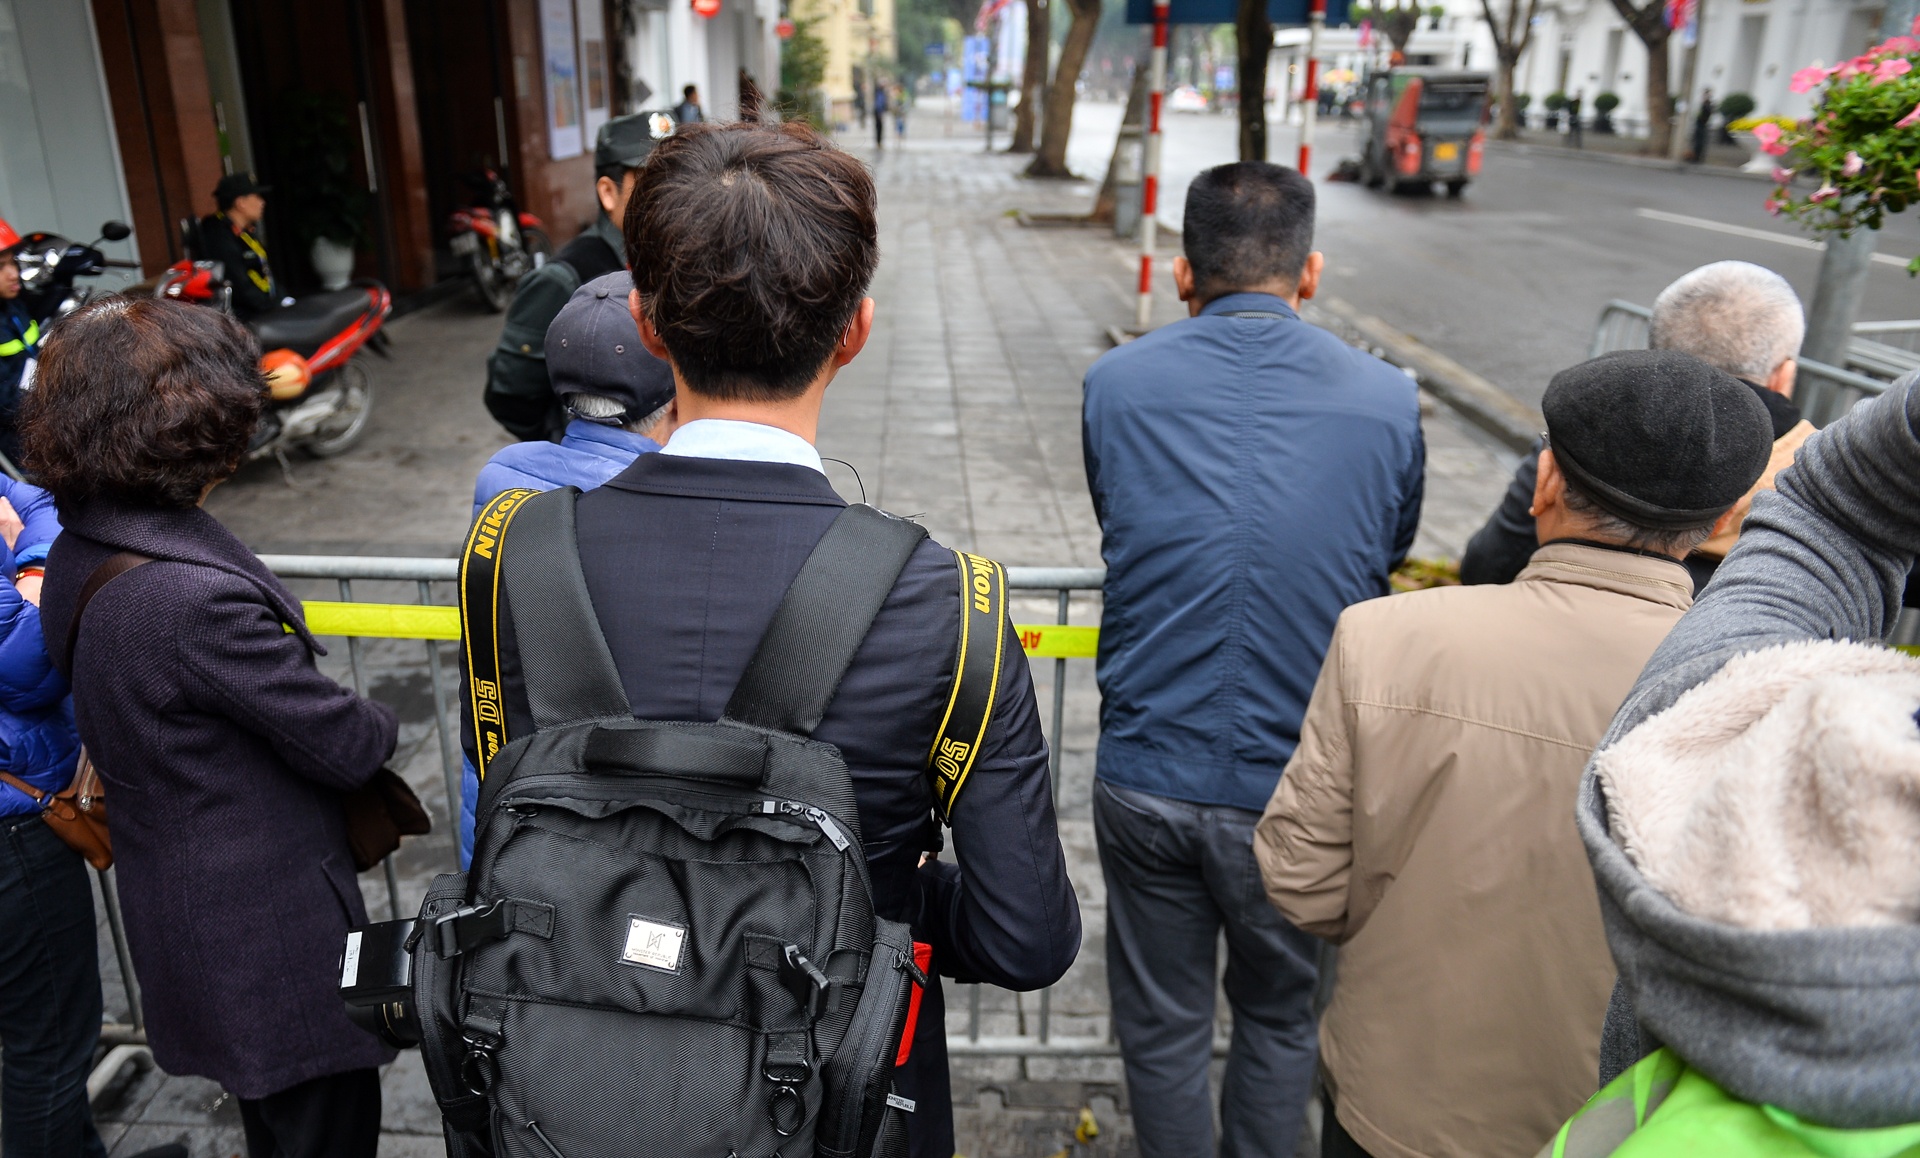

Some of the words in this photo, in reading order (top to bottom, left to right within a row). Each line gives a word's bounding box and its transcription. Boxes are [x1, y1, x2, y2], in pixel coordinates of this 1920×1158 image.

[474, 491, 529, 560] Nikon
[475, 677, 500, 726] D5
[935, 737, 970, 781] D5
